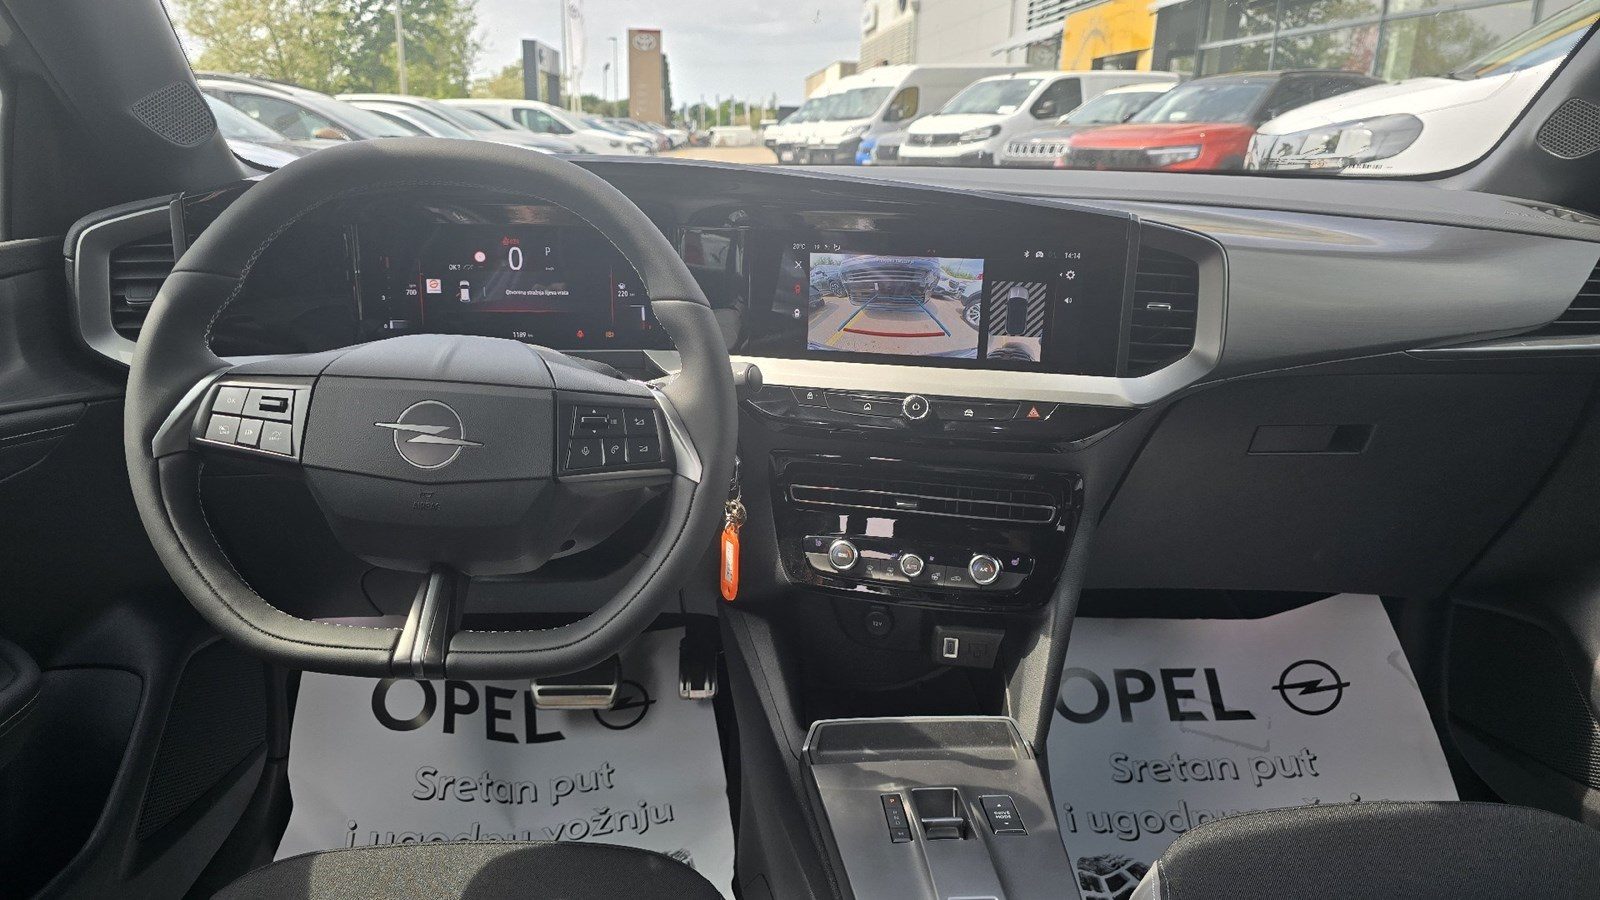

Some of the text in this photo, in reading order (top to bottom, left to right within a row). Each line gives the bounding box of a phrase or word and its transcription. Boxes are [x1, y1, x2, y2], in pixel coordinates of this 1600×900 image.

[508, 246, 523, 271] 0
[545, 246, 551, 256] P
[371, 677, 566, 744] OPEL
[1057, 667, 1257, 725] OPEL
[411, 761, 616, 806] Sretan put
[1108, 746, 1320, 788] Sretan put
[542, 798, 675, 842] vožnju
[1062, 801, 1077, 834] i
